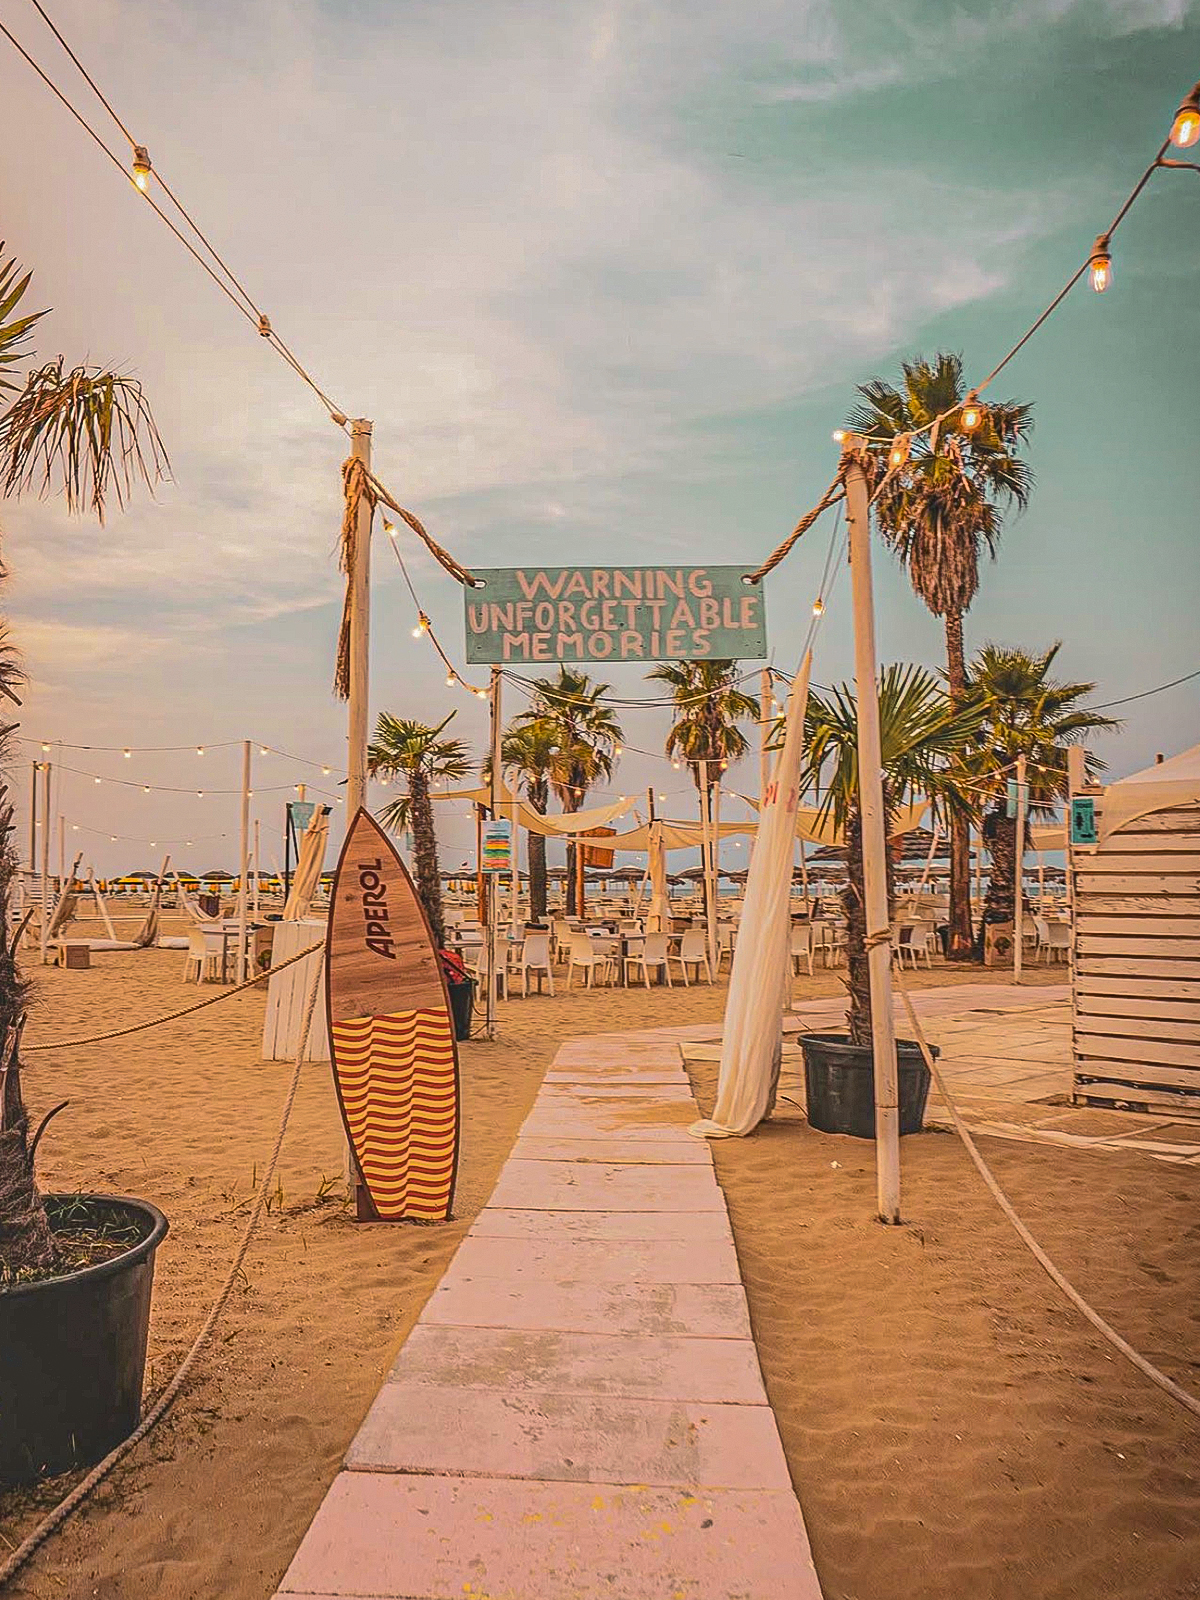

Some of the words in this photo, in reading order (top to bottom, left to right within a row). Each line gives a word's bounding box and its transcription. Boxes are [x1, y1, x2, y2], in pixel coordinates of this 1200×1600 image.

[515, 569, 713, 600] WARNING
[468, 597, 759, 634] UNFORGETTABLE
[502, 629, 712, 660] MEMORIES
[358, 858, 396, 959] APEROL
